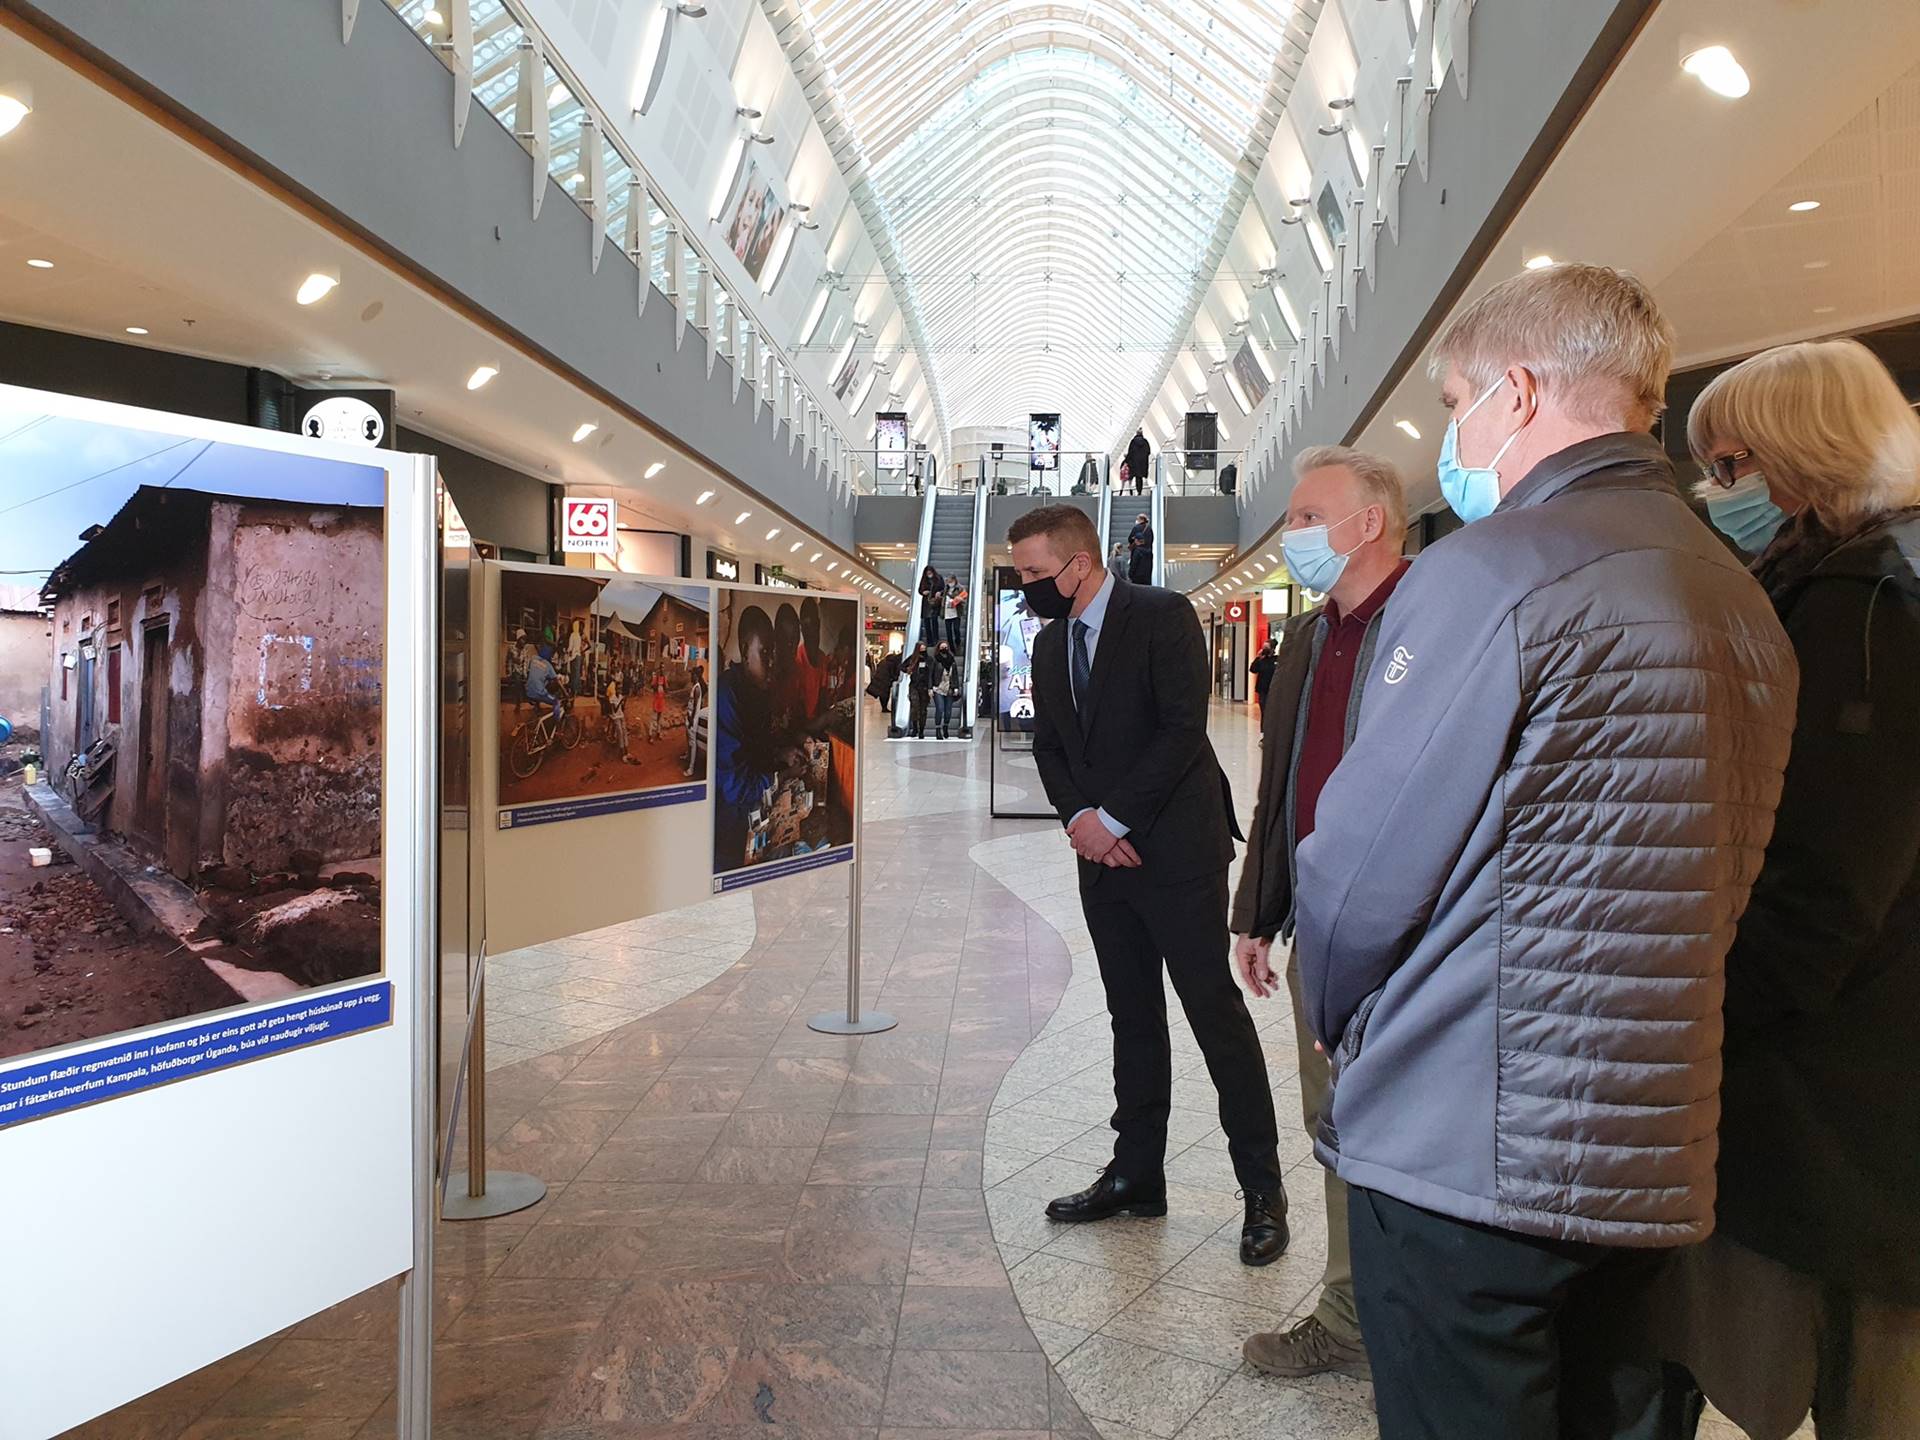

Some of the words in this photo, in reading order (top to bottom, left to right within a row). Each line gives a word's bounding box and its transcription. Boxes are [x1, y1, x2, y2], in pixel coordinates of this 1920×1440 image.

[0, 1101, 17, 1112] nar
[24, 1079, 104, 1105] fátækrahverfum
[106, 1067, 149, 1085] Kampala,
[151, 1053, 204, 1073] höfuðborgar
[206, 1044, 239, 1059] Úganda,
[241, 1039, 256, 1050] búa
[257, 1034, 269, 1045] við
[270, 1027, 303, 1041] nauðugir
[1, 1075, 48, 1093] Stundum
[50, 1066, 80, 1080] flæðir
[81, 1052, 132, 1073] regnvatnið
[134, 1050, 148, 1060] inn
[150, 1046, 154, 1056] í
[155, 1041, 185, 1054] kofann
[187, 1037, 198, 1047] og
[200, 1032, 210, 1044] þá
[212, 1032, 221, 1040] er
[222, 1026, 239, 1038] eins
[240, 1023, 256, 1035] gott
[257, 1019, 267, 1029] að
[268, 1016, 285, 1028] geta
[286, 1011, 307, 1022] hengt
[308, 1001, 342, 1016] húsbúnað
[344, 998, 357, 1009] upp
[358, 995, 363, 1004] á
[364, 993, 381, 1003] vegg.
